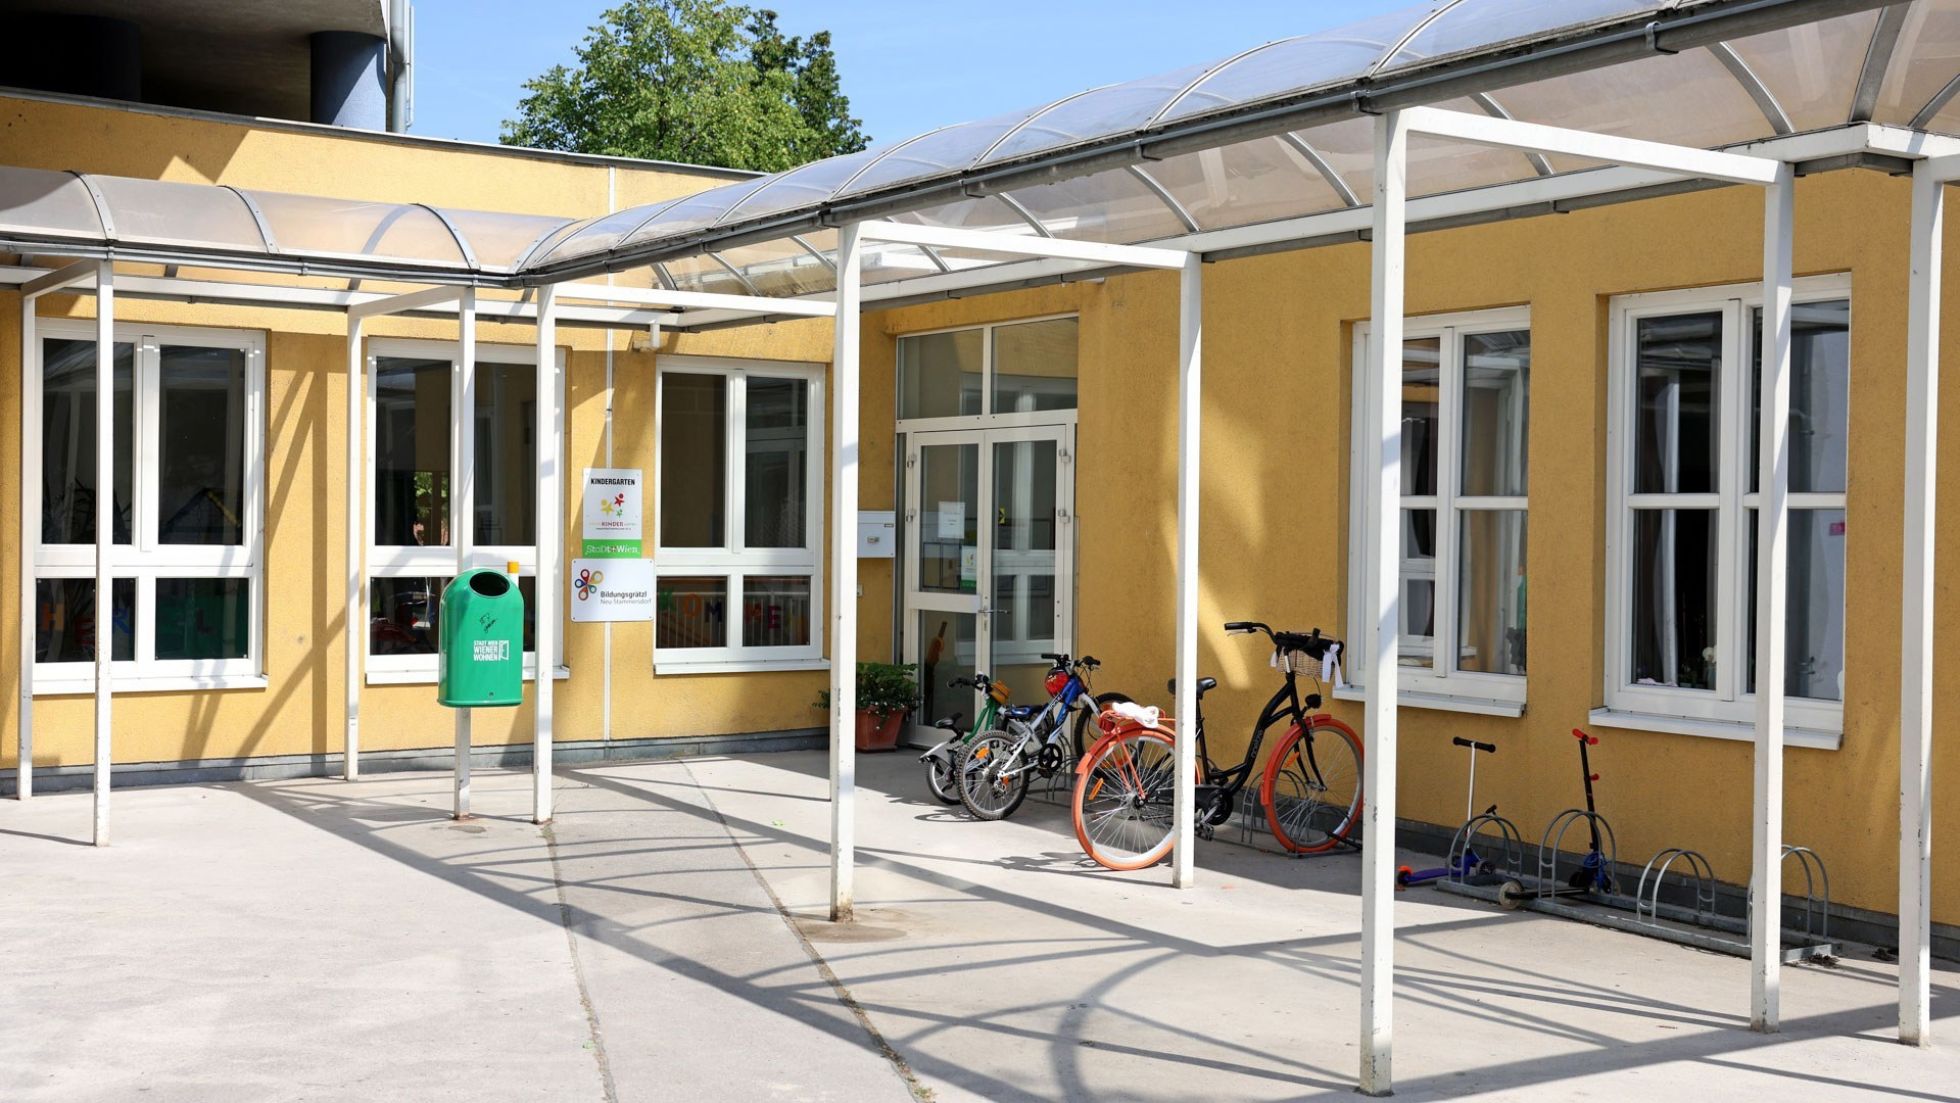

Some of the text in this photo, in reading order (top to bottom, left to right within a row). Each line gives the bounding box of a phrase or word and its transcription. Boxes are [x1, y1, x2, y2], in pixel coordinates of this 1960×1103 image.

[590, 478, 635, 486] KINDERGARTEN
[473, 646, 498, 654] WIENER
[473, 653, 498, 661] WOHNEN
